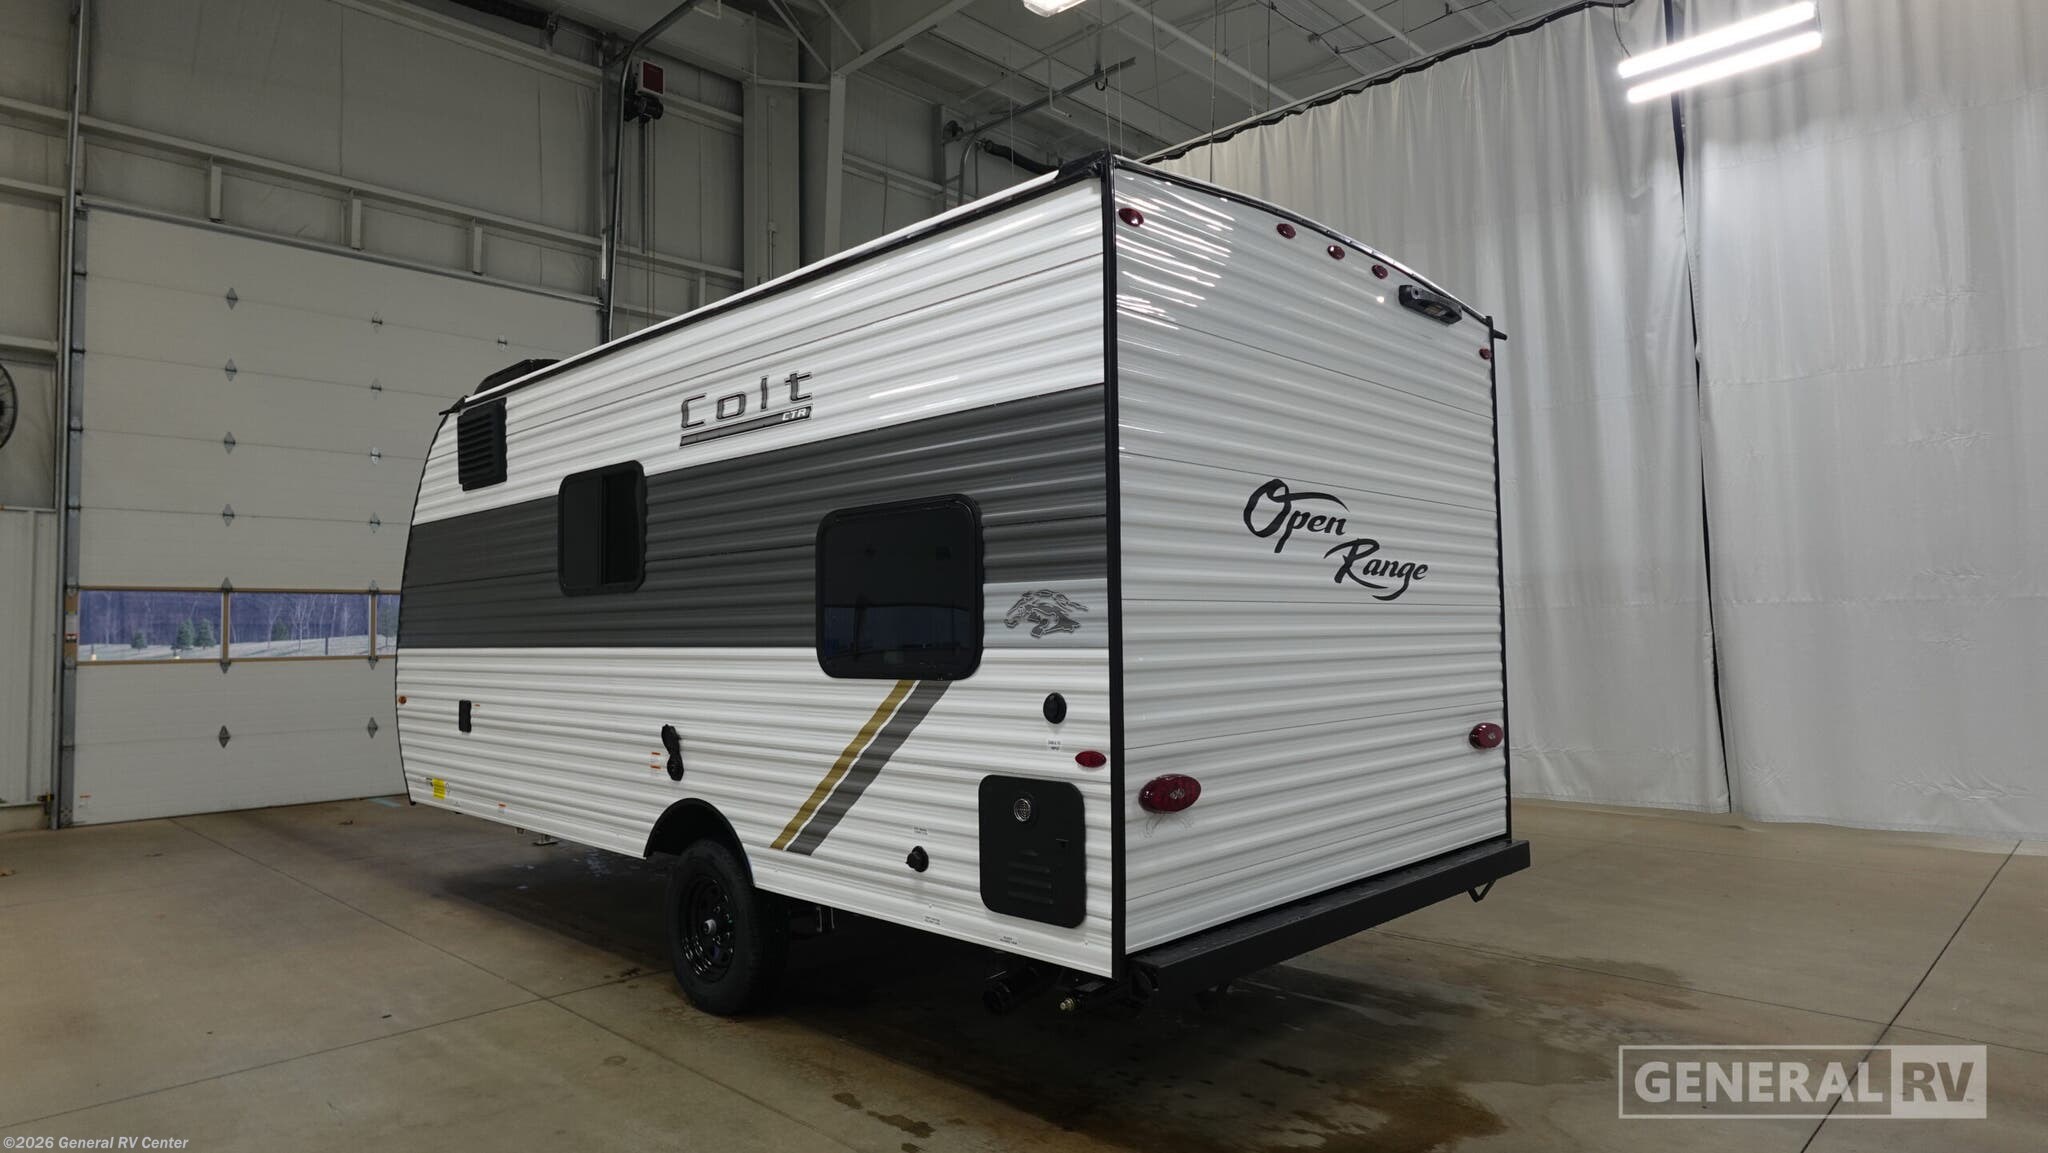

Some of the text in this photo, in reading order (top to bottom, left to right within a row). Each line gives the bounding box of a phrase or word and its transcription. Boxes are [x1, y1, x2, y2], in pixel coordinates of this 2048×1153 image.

[680, 372, 812, 429] Colt
[781, 407, 808, 422] CTR
[1243, 478, 1350, 554] Open
[1323, 538, 1429, 601] Range
